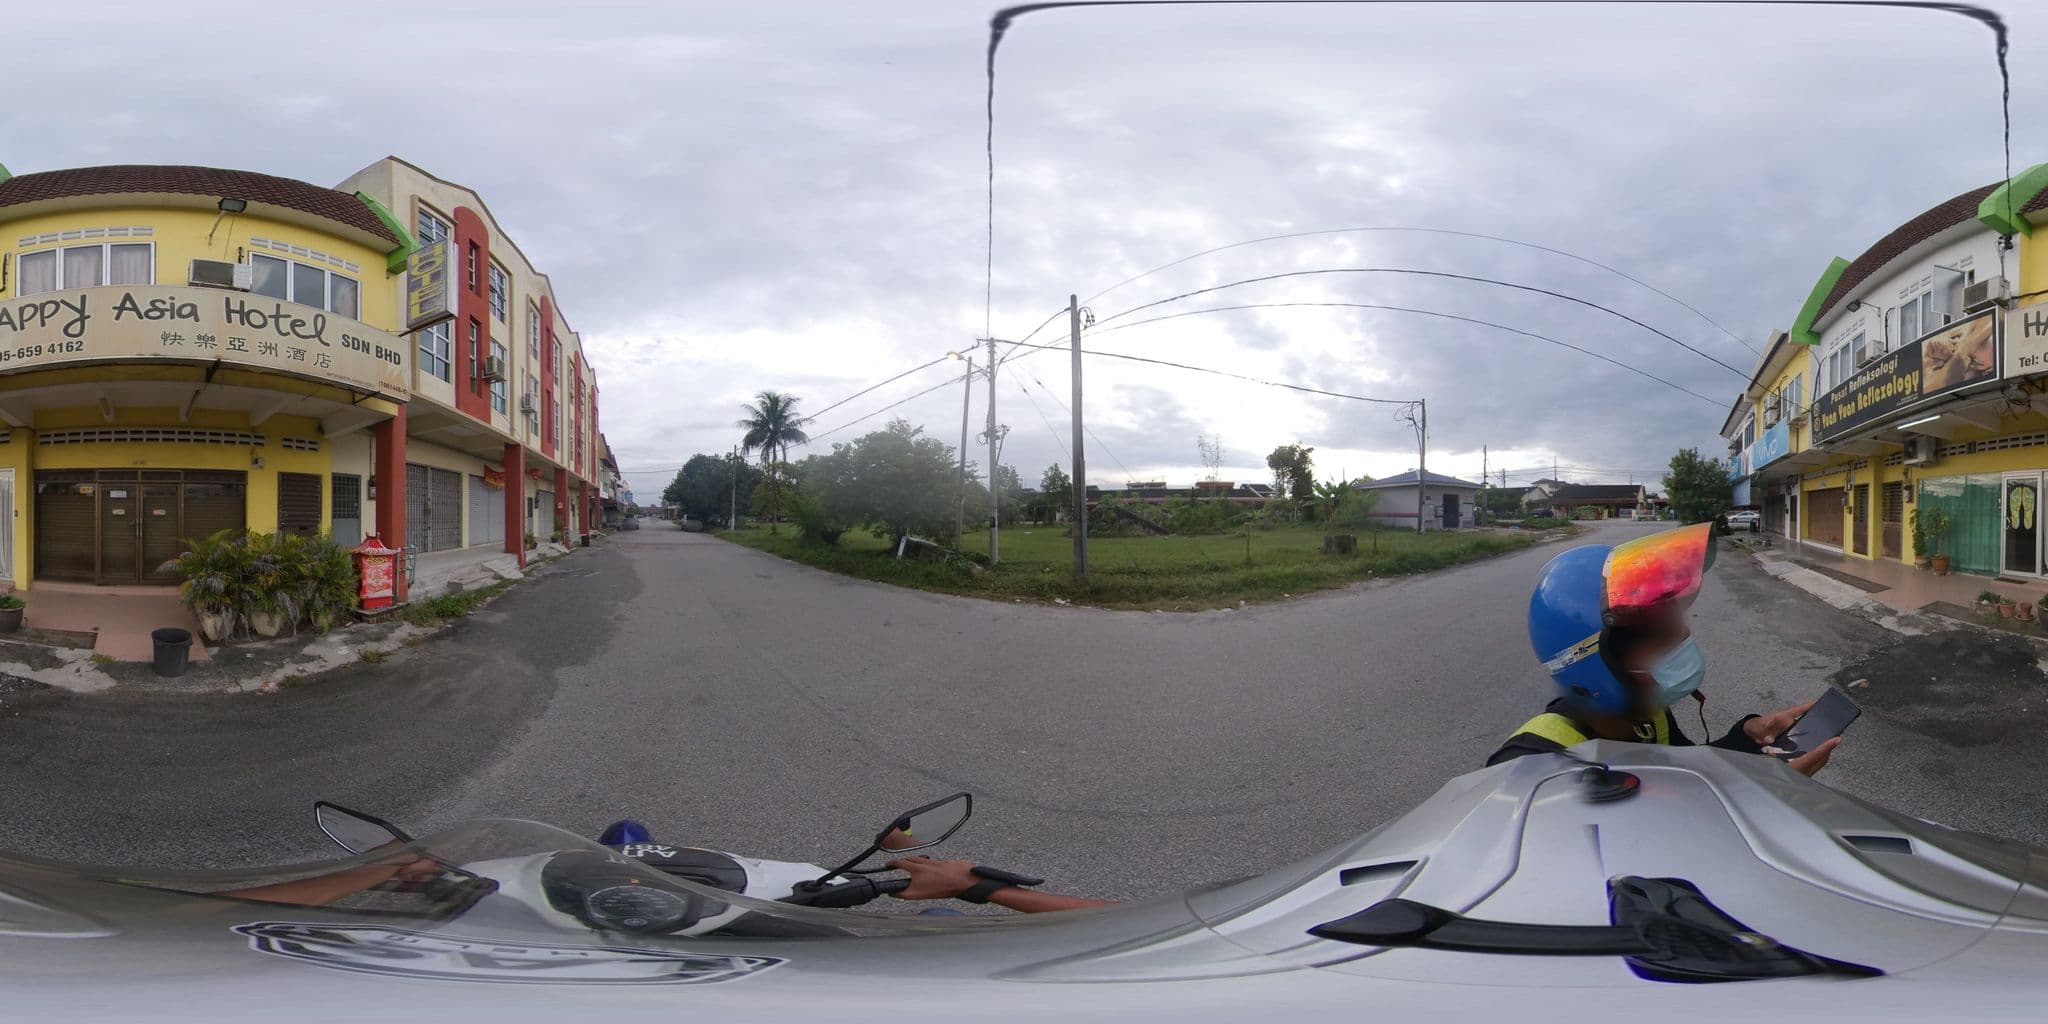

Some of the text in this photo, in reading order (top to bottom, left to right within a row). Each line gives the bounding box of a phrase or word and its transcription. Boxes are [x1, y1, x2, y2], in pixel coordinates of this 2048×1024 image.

[411, 243, 443, 320] HOTEL
[112, 292, 200, 323] Asia
[224, 297, 330, 347] Hotel
[47, 340, 84, 354] 4162
[341, 333, 401, 366] SDN BHD
[2018, 355, 2039, 368] Tel:
[1821, 411, 1838, 429] Yuan
[1838, 400, 1856, 420] Yuan
[1857, 369, 1920, 411] Reflexology
[1830, 354, 1898, 405] Pusat Refleksologi
